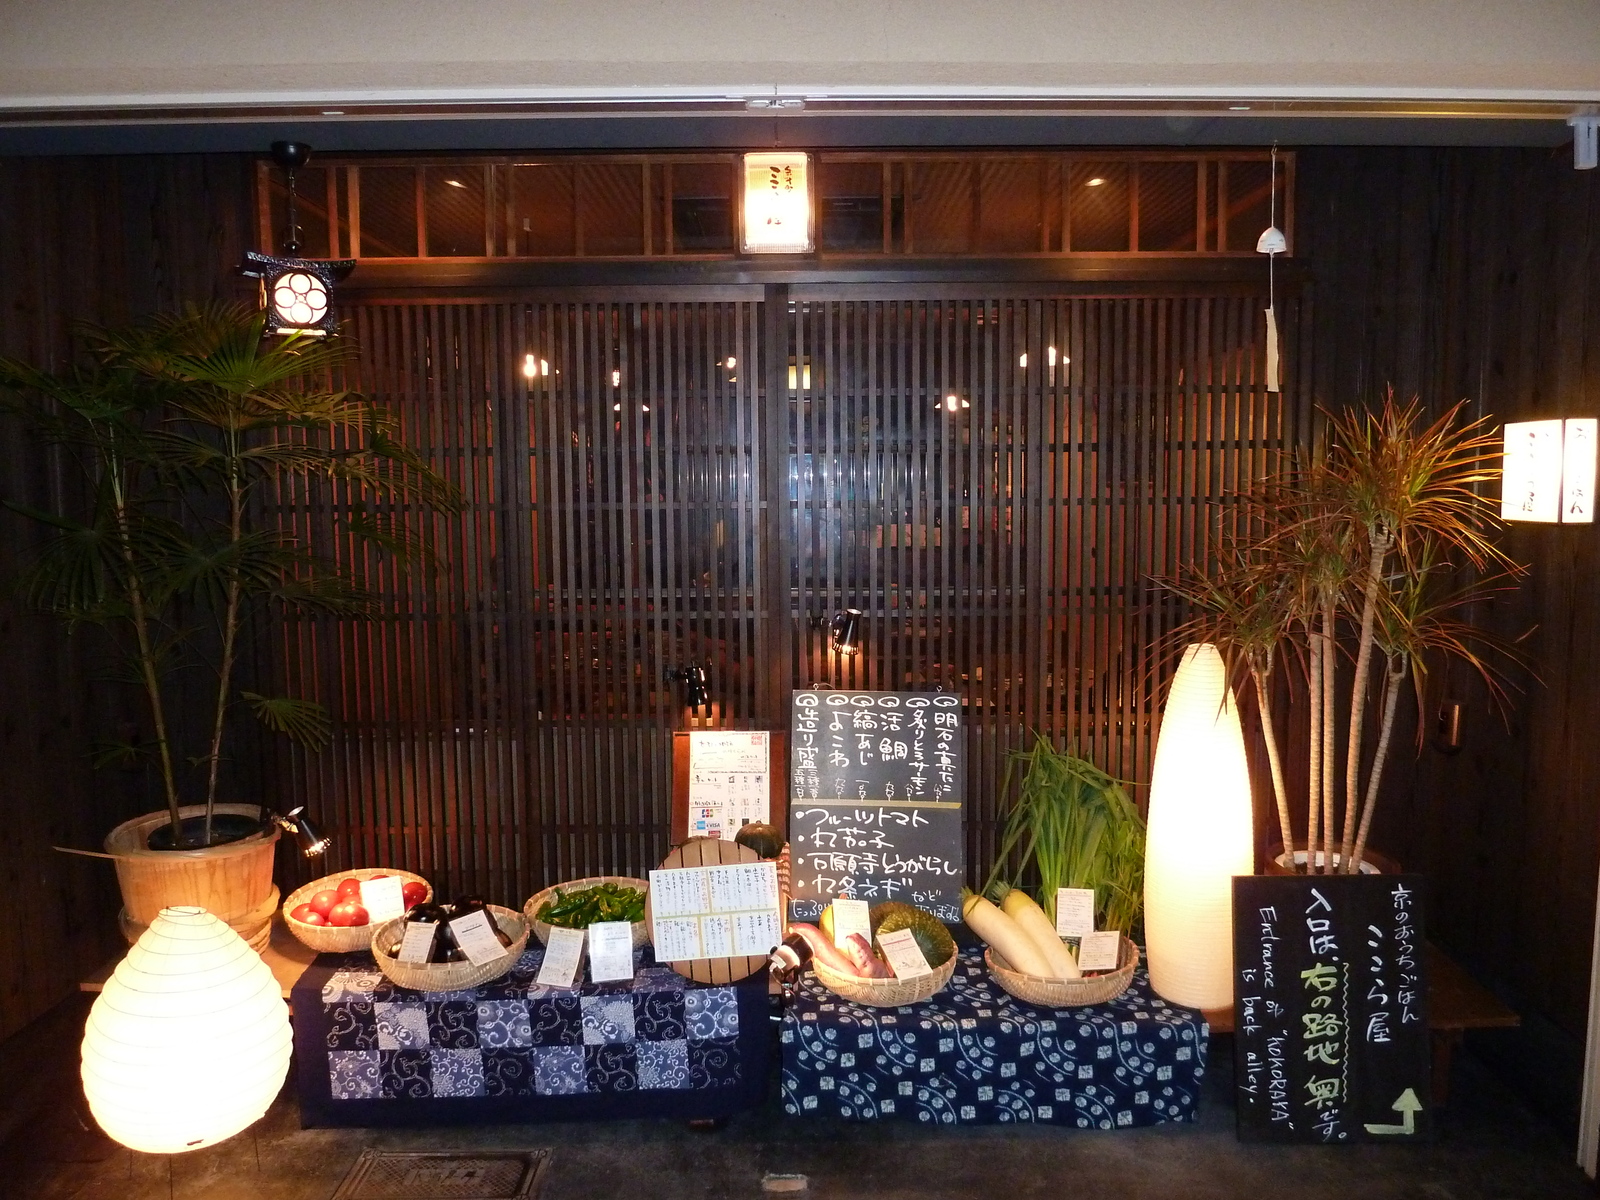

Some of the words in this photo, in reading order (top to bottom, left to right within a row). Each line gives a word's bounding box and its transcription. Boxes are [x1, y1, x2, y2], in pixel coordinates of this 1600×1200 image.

[829, 711, 852, 767] よこわ
[853, 709, 878, 766] 縞あじ
[879, 712, 908, 761] 活鯛
[805, 807, 929, 827] フルーツトマト
[912, 889, 942, 903] など
[1259, 905, 1281, 989] Entrance
[1242, 968, 1257, 982] is
[1366, 924, 1391, 1042] ここら屋
[1242, 996, 1262, 1036] back
[1239, 1051, 1264, 1103] alley.
